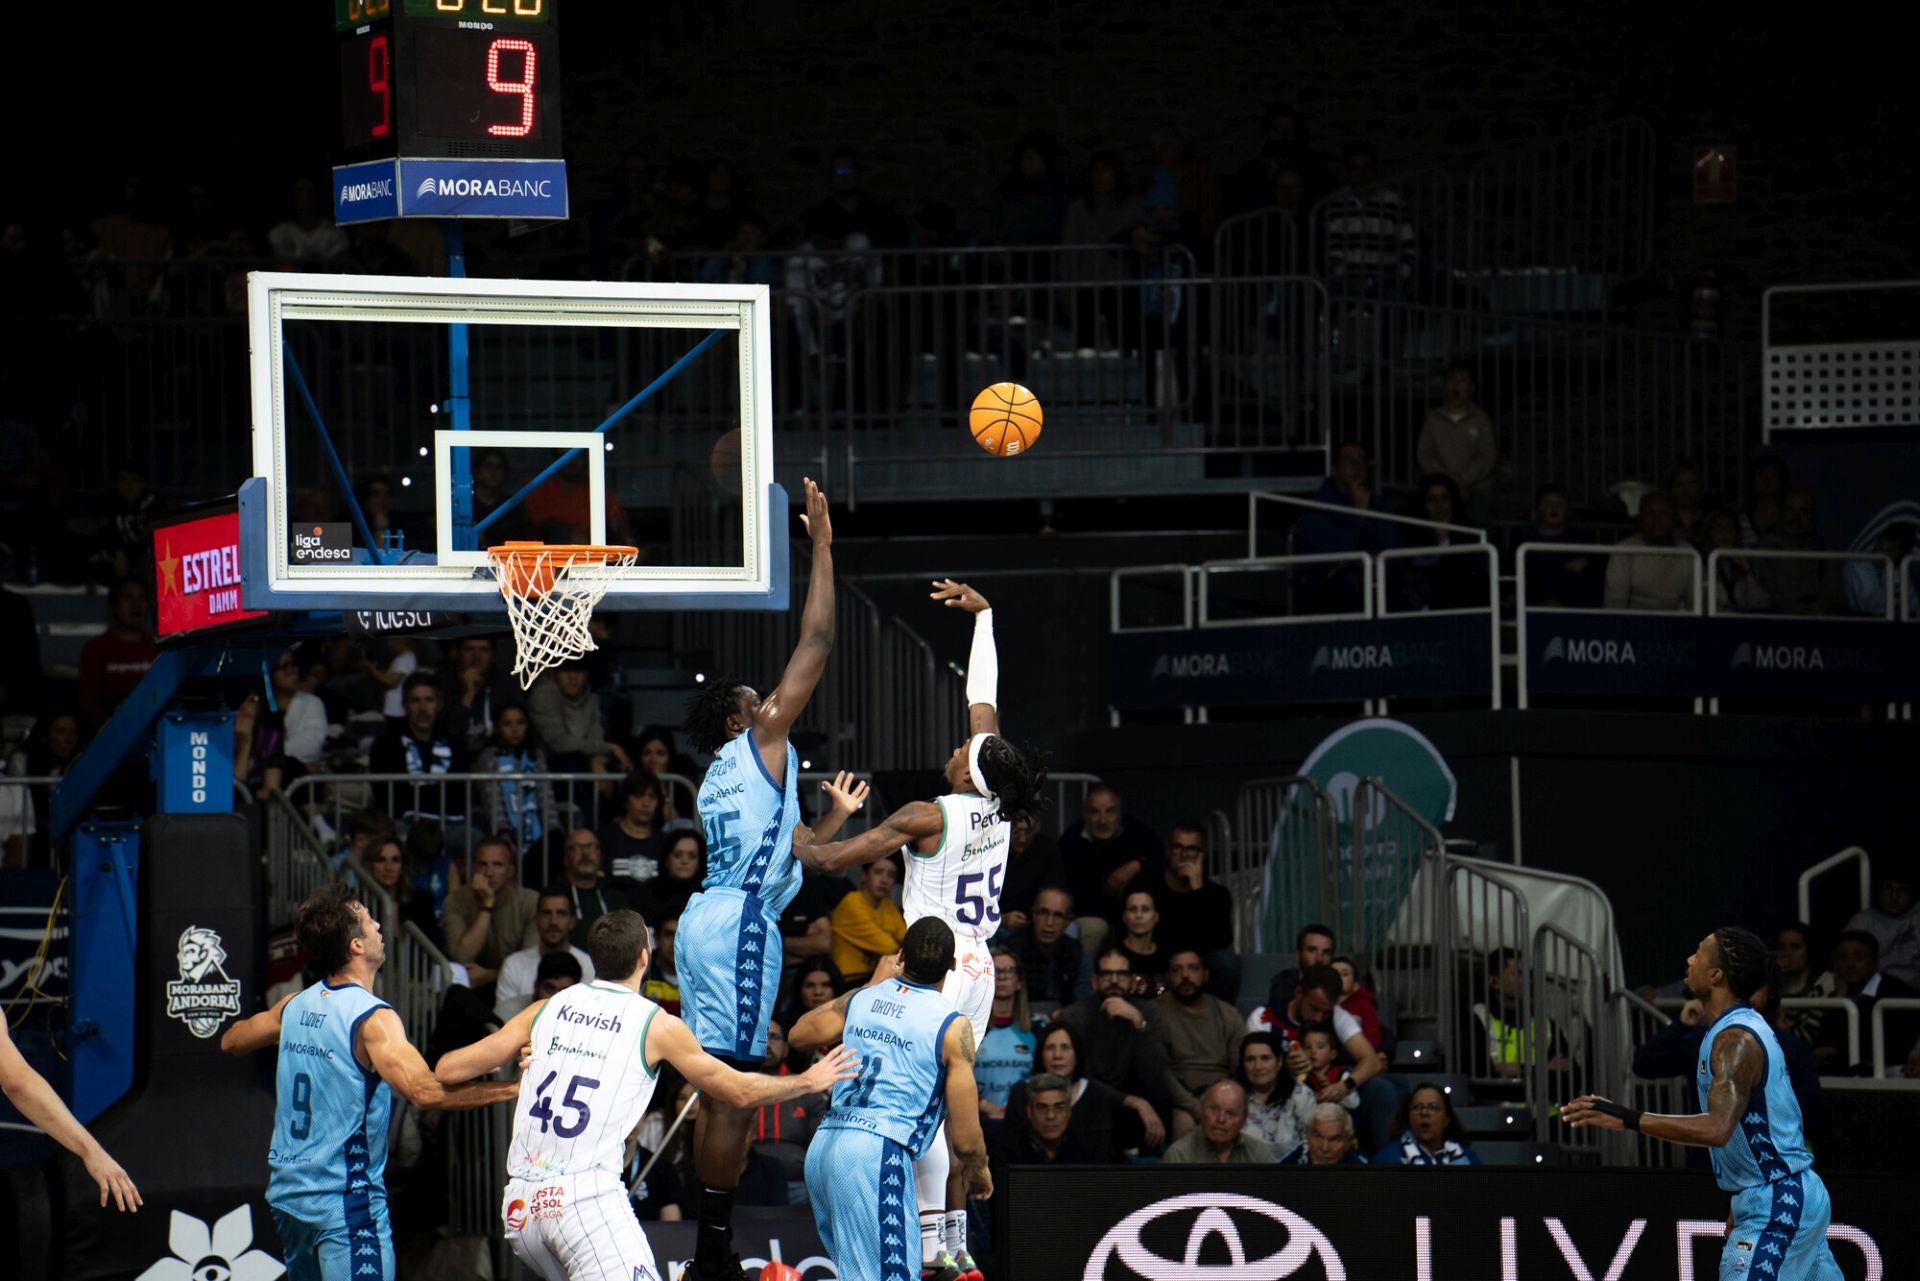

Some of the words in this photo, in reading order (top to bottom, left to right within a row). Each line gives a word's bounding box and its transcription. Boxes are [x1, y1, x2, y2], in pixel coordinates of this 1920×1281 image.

[458, 20, 494, 31] MONDO
[367, 35, 391, 137] 9
[486, 38, 537, 136] 9
[347, 178, 393, 202] MORABANC
[438, 179, 552, 198] MORABANC
[295, 533, 321, 549] liga
[295, 547, 351, 560] endesa
[208, 590, 238, 614] DAMM
[190, 731, 208, 804] MONDO
[171, 983, 237, 995] MORABANC
[171, 995, 237, 1012] ANDORRA
[870, 998, 907, 1019] OKOYE
[556, 1004, 622, 1033] Kravish
[854, 1027, 914, 1052] MORABANC
[290, 1072, 312, 1141] 9
[529, 1070, 601, 1139] 45
[543, 1199, 563, 1209] SOL
